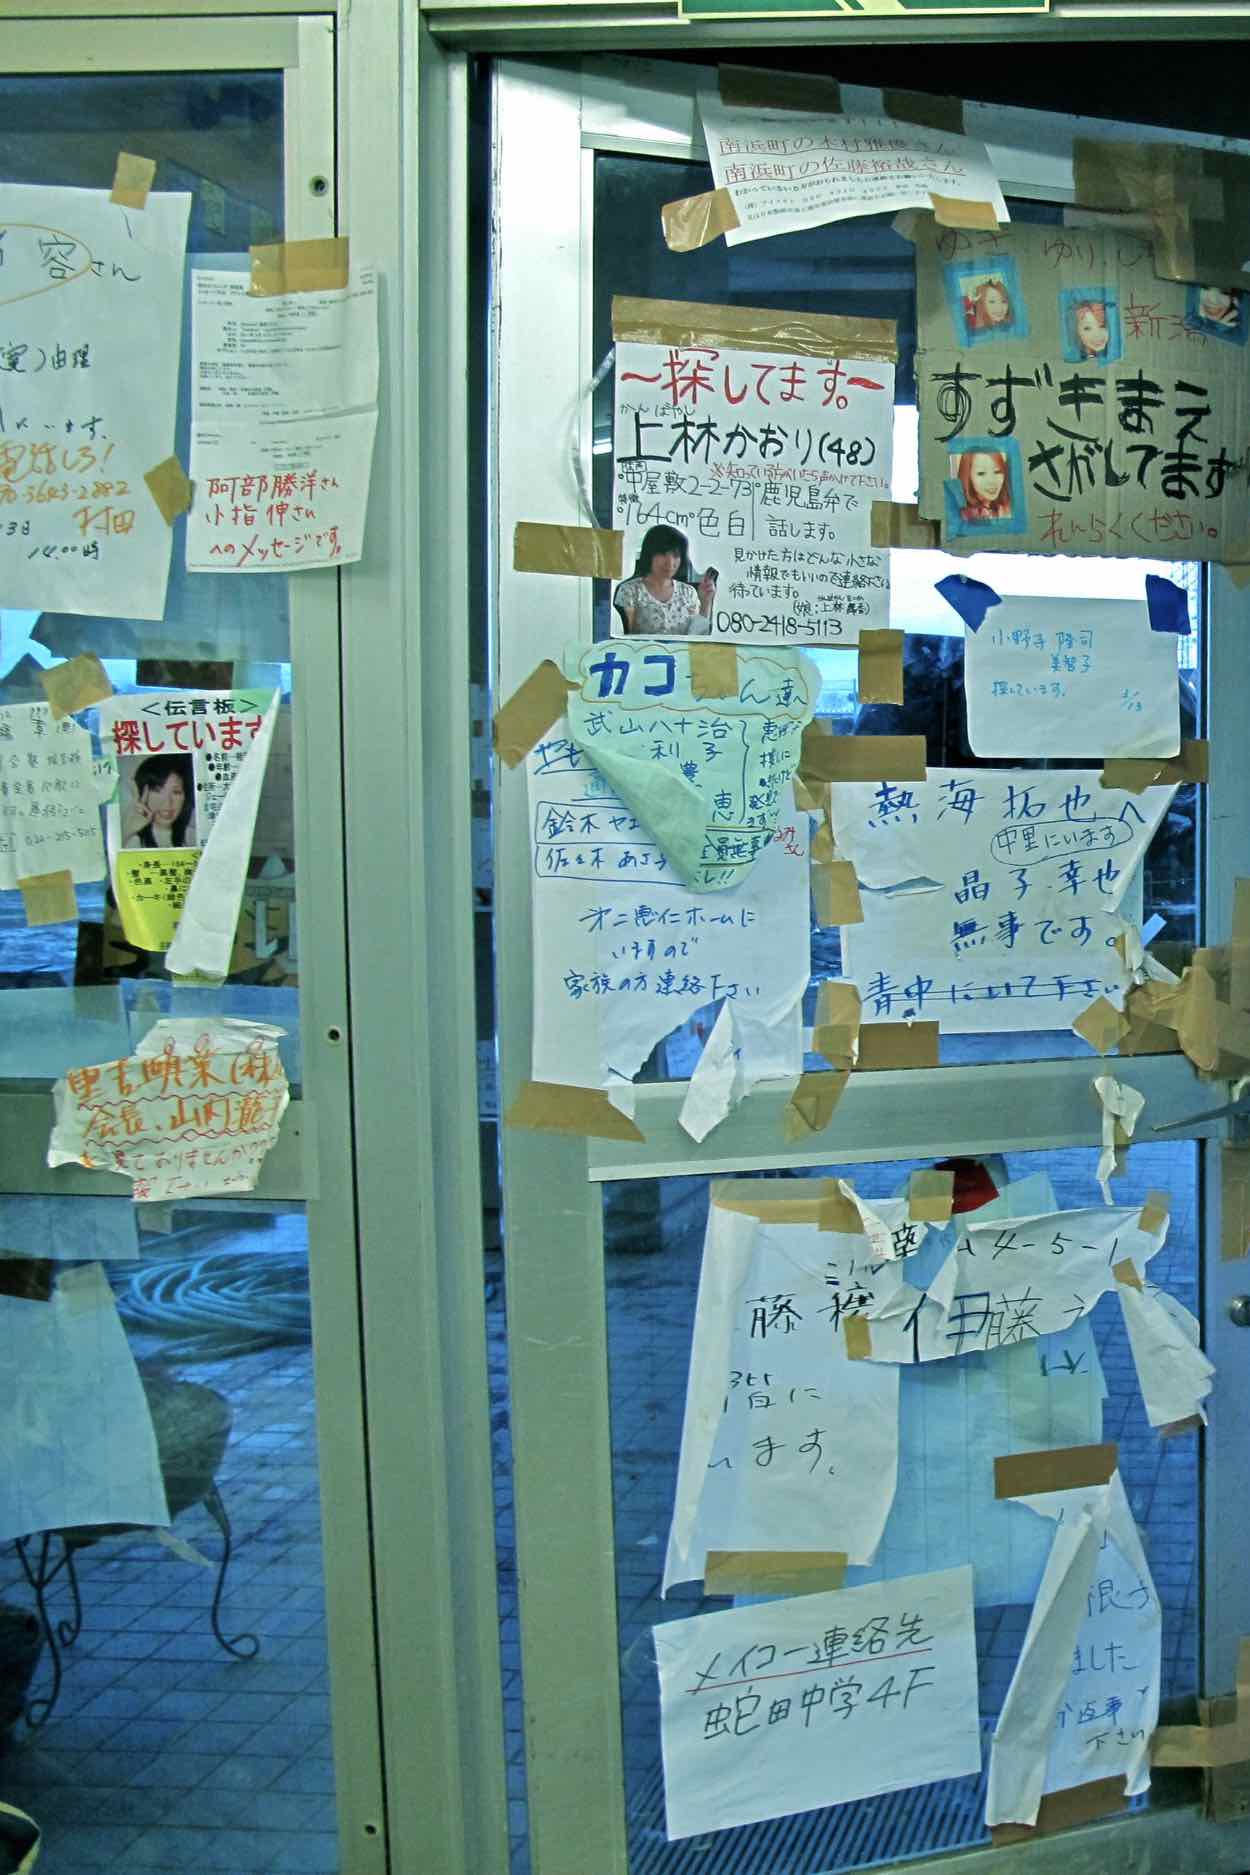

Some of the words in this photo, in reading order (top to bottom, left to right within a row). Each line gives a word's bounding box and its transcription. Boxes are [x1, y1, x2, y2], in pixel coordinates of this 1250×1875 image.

[1028, 438, 1230, 502] さがしてます
[717, 611, 843, 637] 080-2418-5113
[694, 1612, 936, 1686] メイコー連絡先
[703, 1665, 937, 1741] 蛇田中学4F
